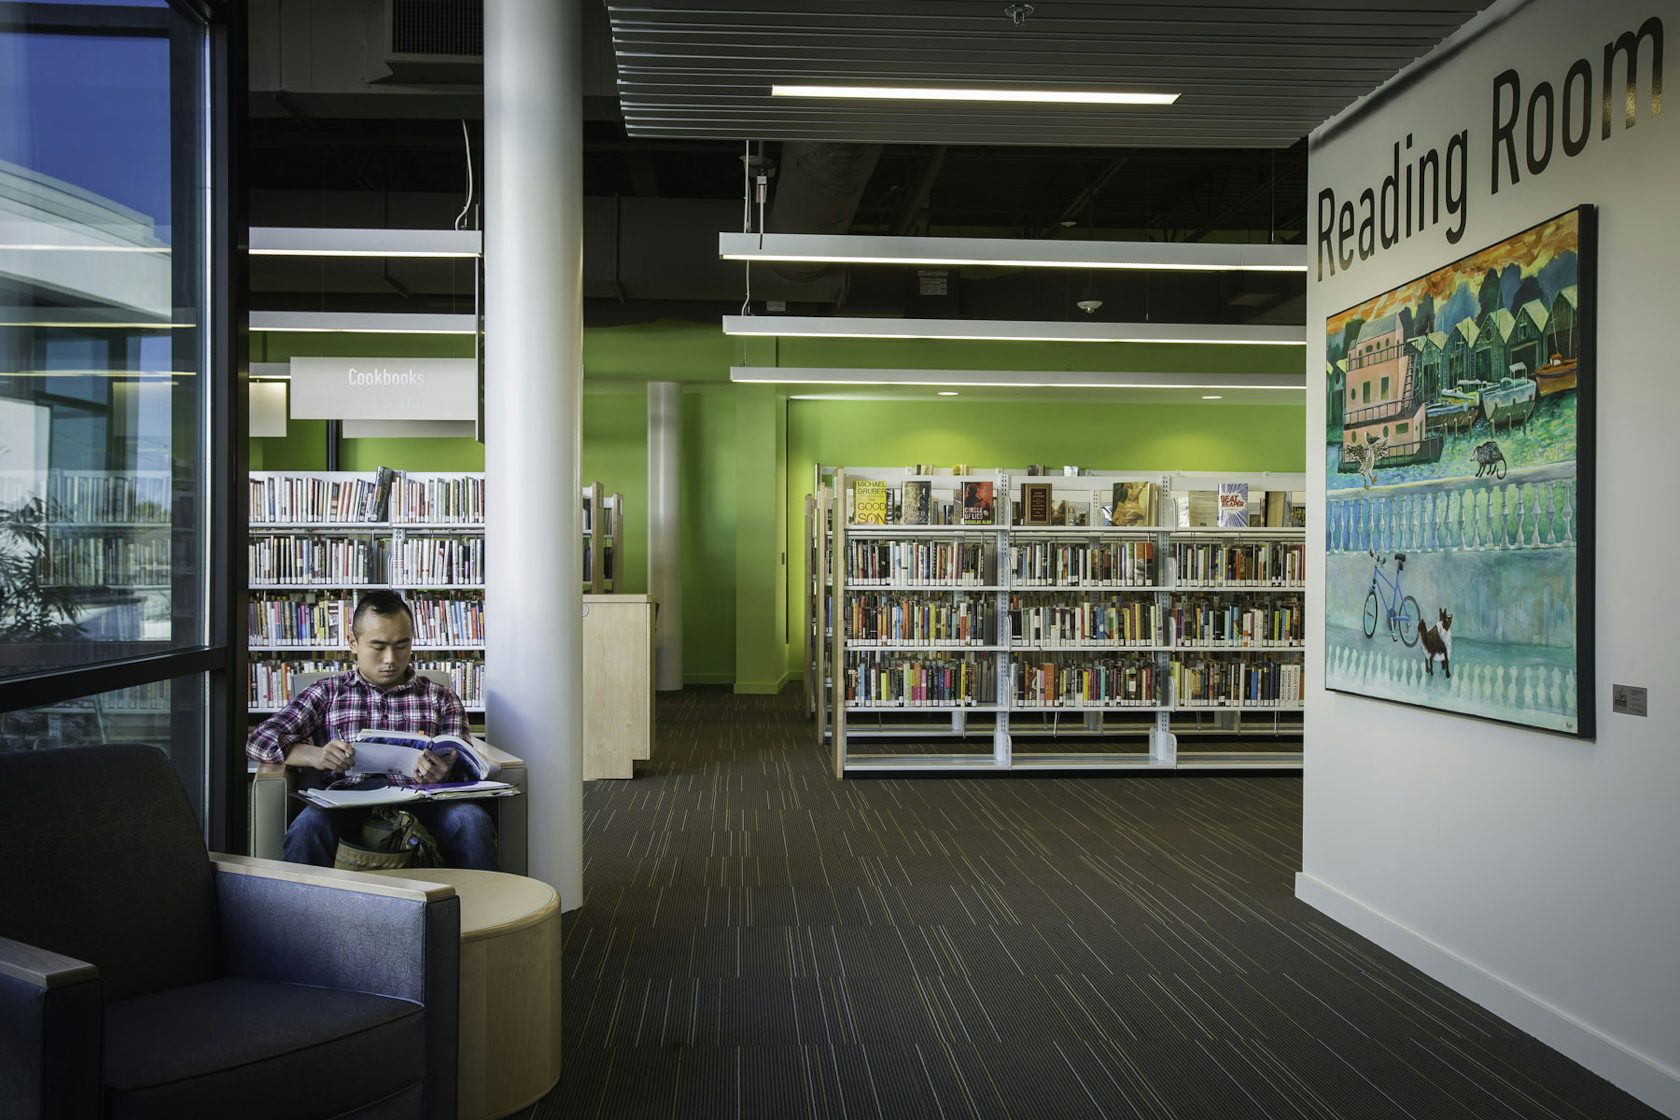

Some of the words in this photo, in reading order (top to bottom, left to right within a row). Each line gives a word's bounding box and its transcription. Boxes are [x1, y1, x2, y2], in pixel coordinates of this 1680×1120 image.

[1317, 129, 1468, 282] Reading
[1491, 16, 1664, 195] Room
[348, 368, 425, 386] Cookbooks
[858, 502, 887, 511] GOOD
[858, 513, 887, 525] SON
